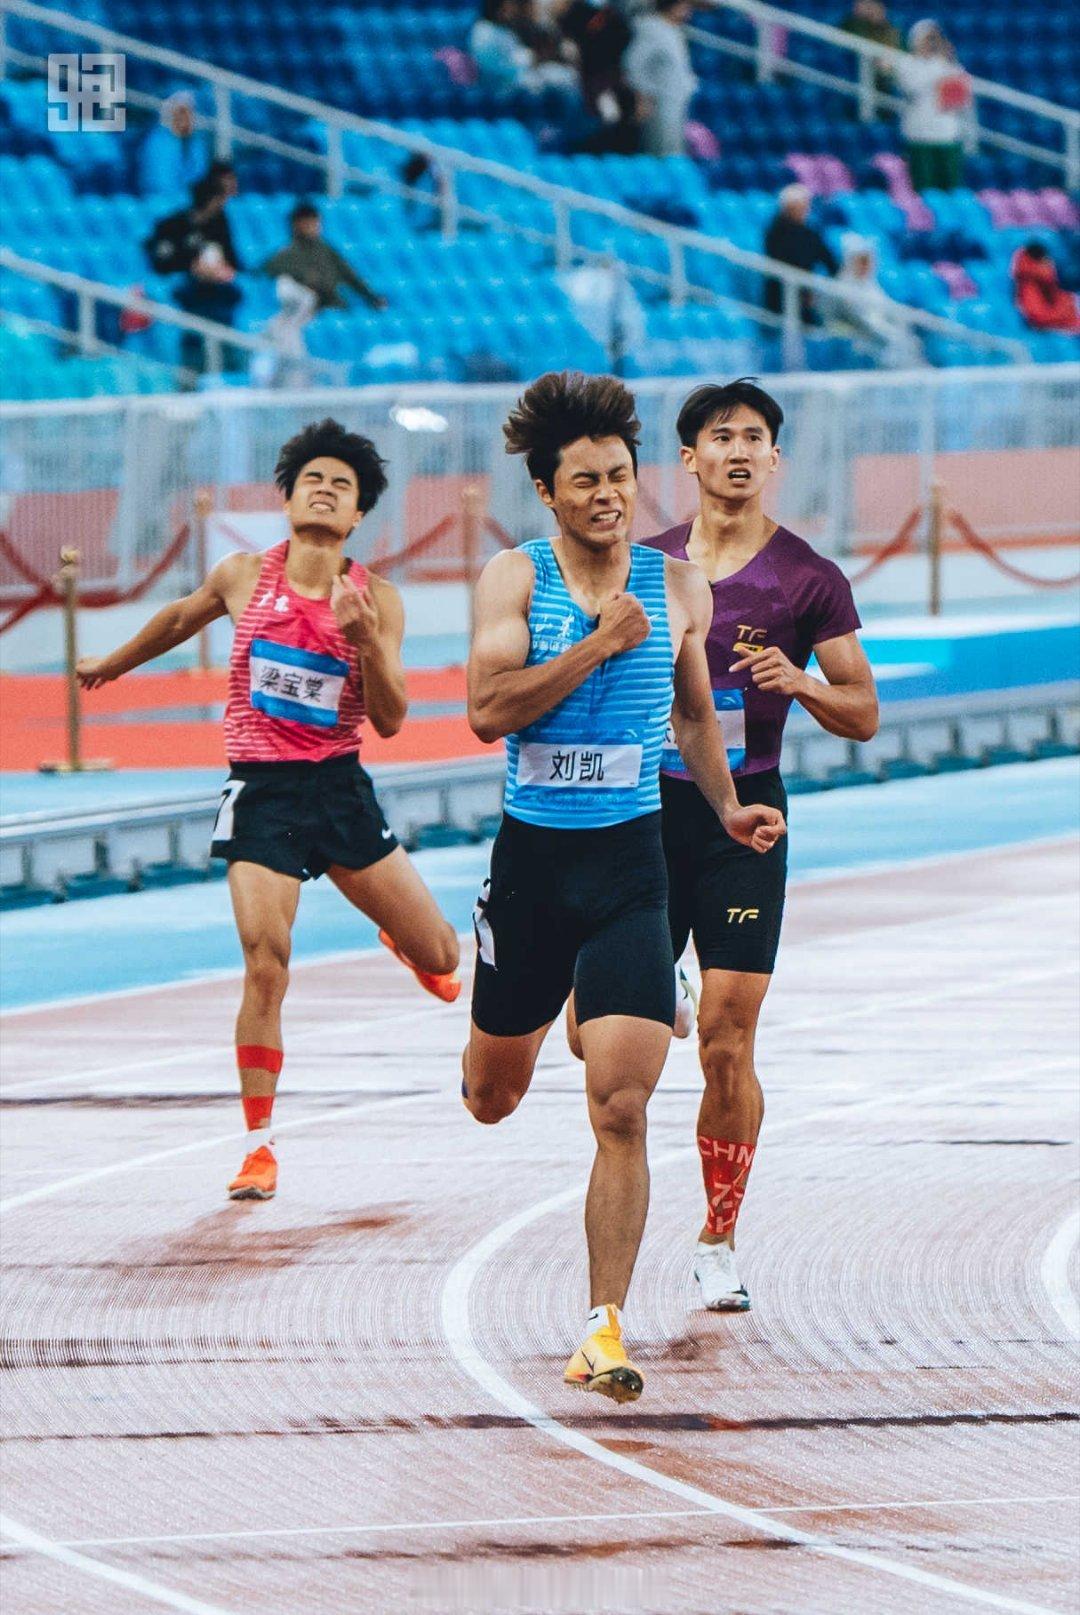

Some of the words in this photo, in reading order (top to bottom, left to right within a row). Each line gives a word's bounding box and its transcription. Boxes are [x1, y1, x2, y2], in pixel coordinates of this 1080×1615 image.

[736, 624, 768, 642] TF
[550, 750, 604, 782] 刘凯
[727, 907, 759, 924] TF
